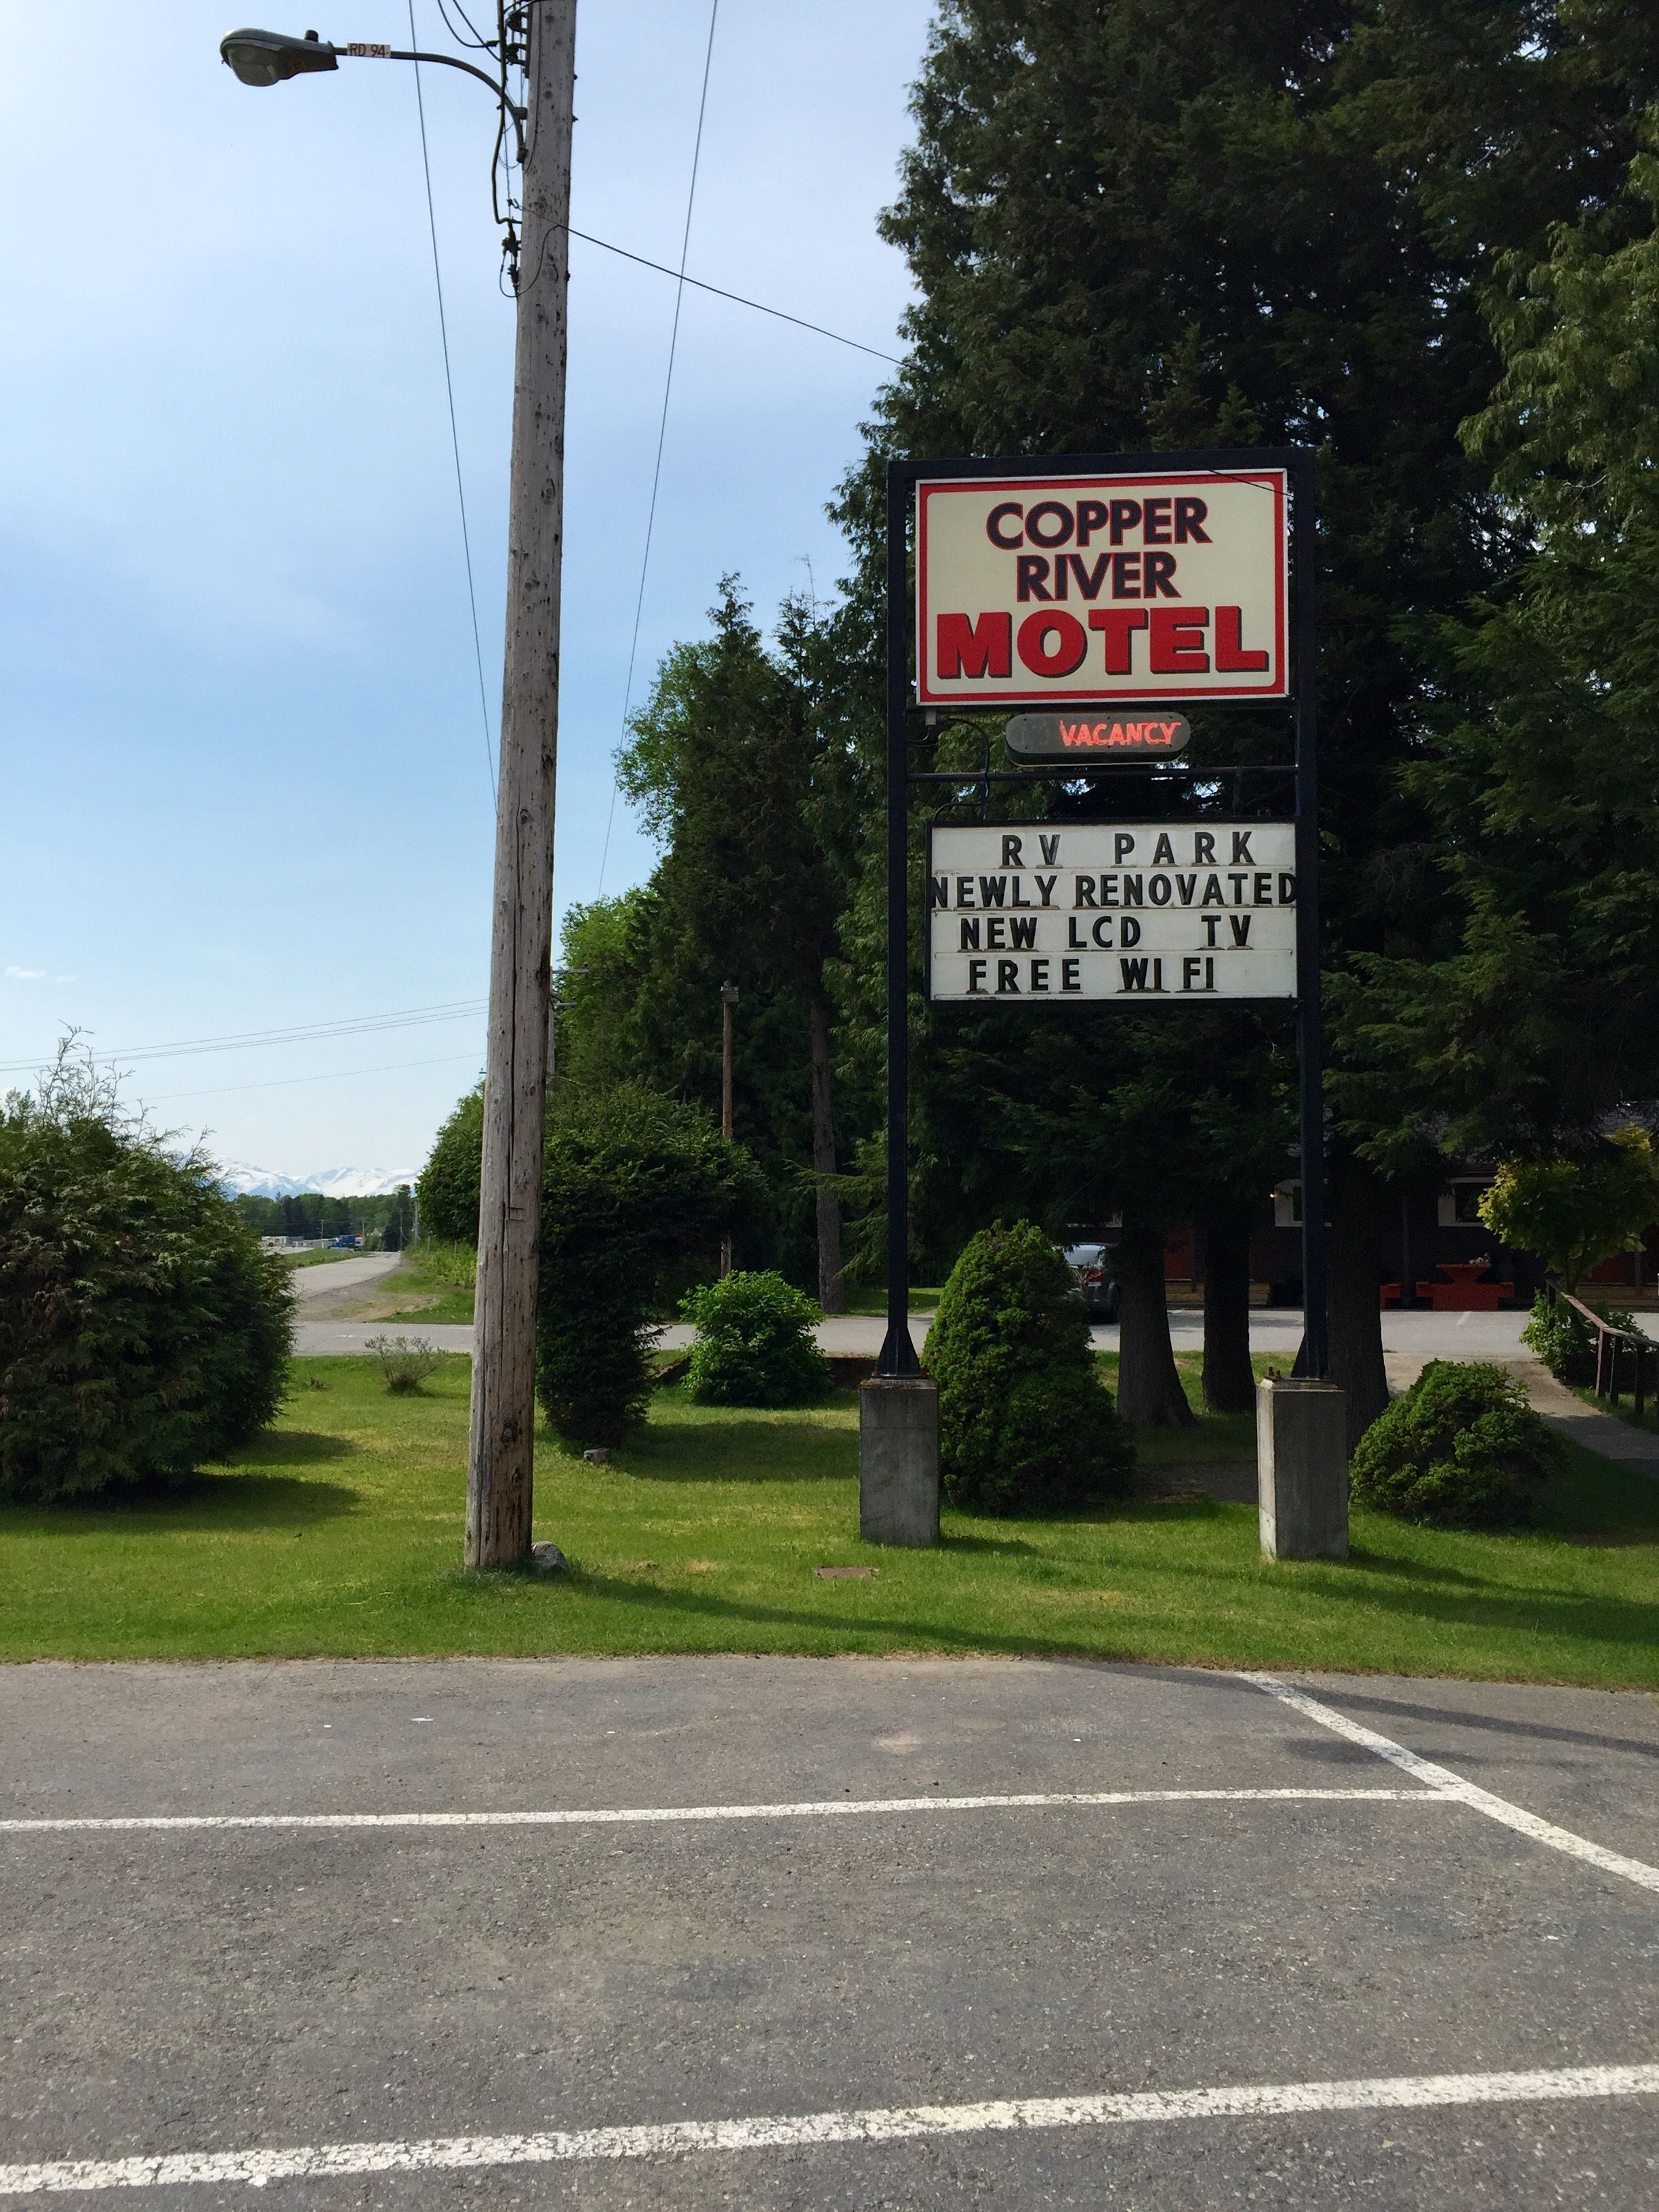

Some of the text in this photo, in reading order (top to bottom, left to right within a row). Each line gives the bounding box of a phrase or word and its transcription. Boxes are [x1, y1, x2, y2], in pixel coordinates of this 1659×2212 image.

[350, 43, 367, 57] RD
[986, 496, 1213, 550] COPPER
[1017, 551, 1182, 602] RIVER
[937, 605, 1270, 680] MOTEL
[1058, 720, 1182, 746] VACANCY
[1002, 831, 1255, 867] RV PARK
[931, 872, 1297, 908] NEWLY RENOVATED
[960, 914, 1252, 949] NEW LCD TV
[968, 958, 1082, 991] FREE
